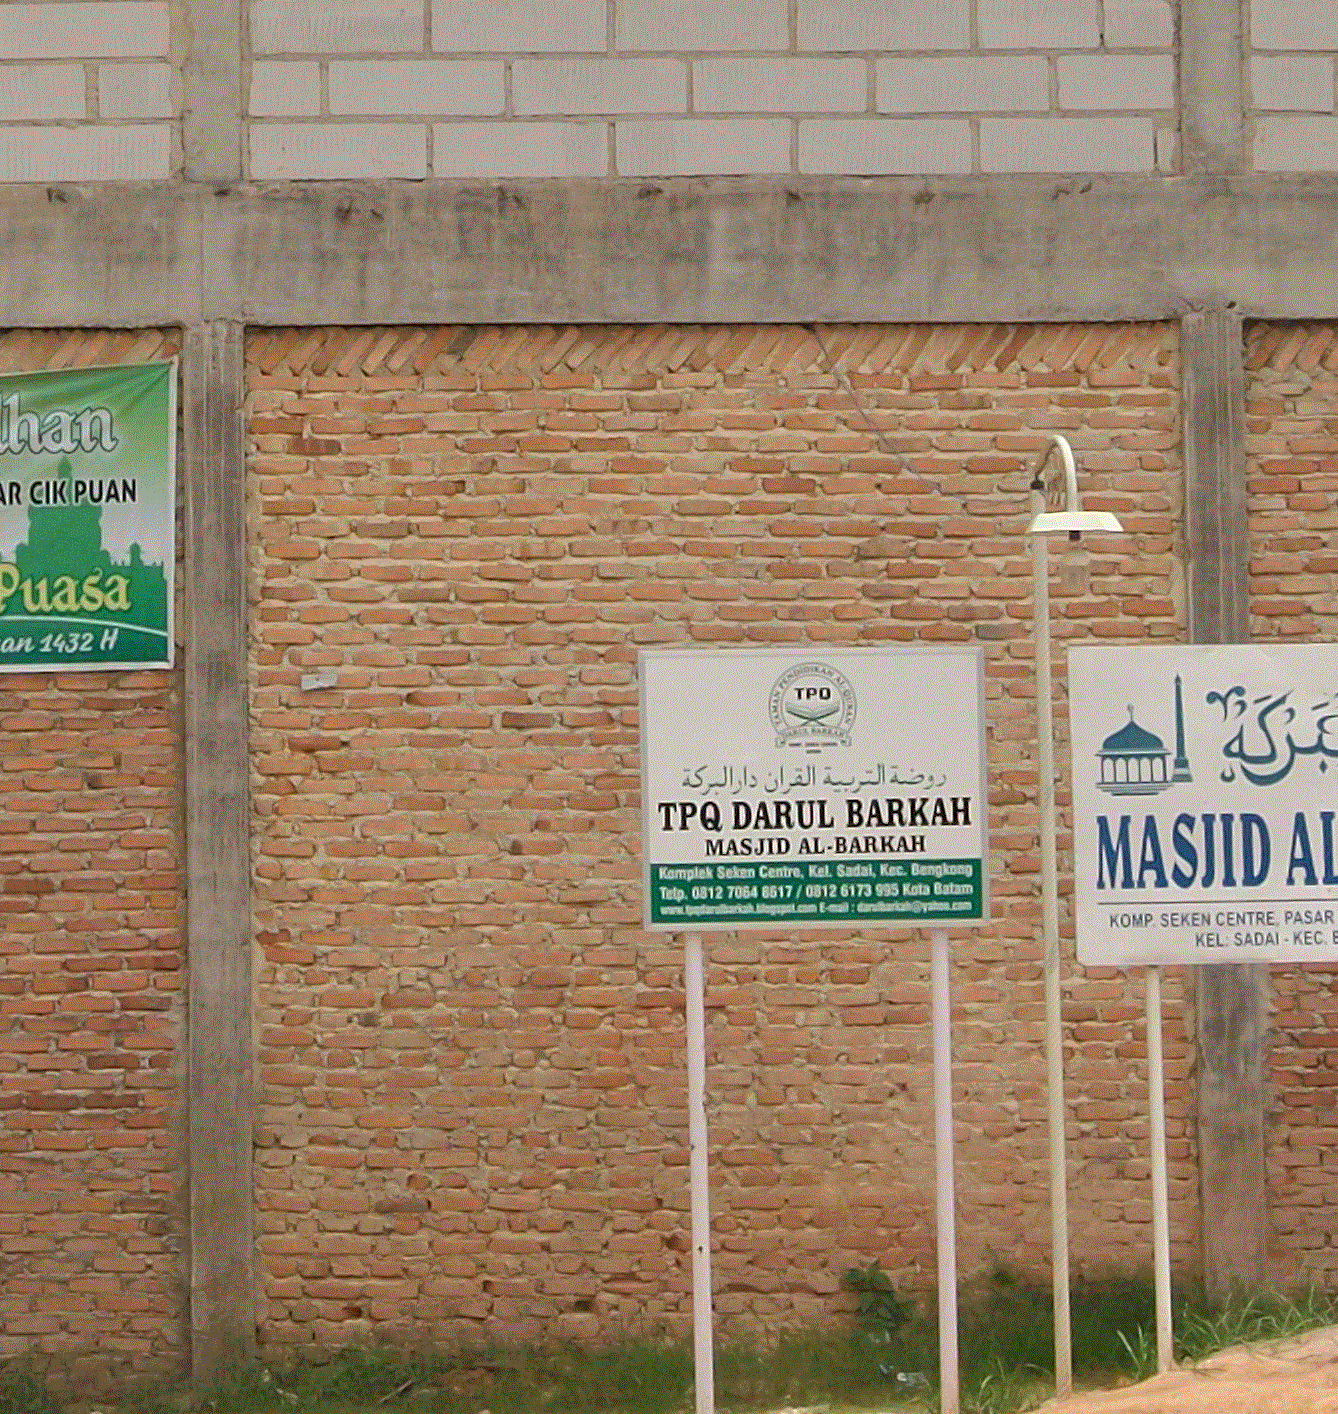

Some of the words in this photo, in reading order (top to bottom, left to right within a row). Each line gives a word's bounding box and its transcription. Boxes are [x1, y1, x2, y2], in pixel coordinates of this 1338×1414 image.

[29, 479, 67, 506] CIK
[74, 478, 138, 504] PUAN
[40, 631, 93, 654] 1432
[99, 627, 118, 652] H
[657, 800, 724, 833] TPQ
[731, 799, 834, 831] DARUL
[845, 795, 973, 829] BARKAH
[704, 837, 791, 858] MASJID
[798, 834, 927, 856] AL-BARKAH
[1096, 813, 1271, 889] MASJID
[1161, 912, 1211, 927] SEKEN
[1284, 910, 1334, 925] PASAR
[1234, 931, 1280, 946] SADAI
